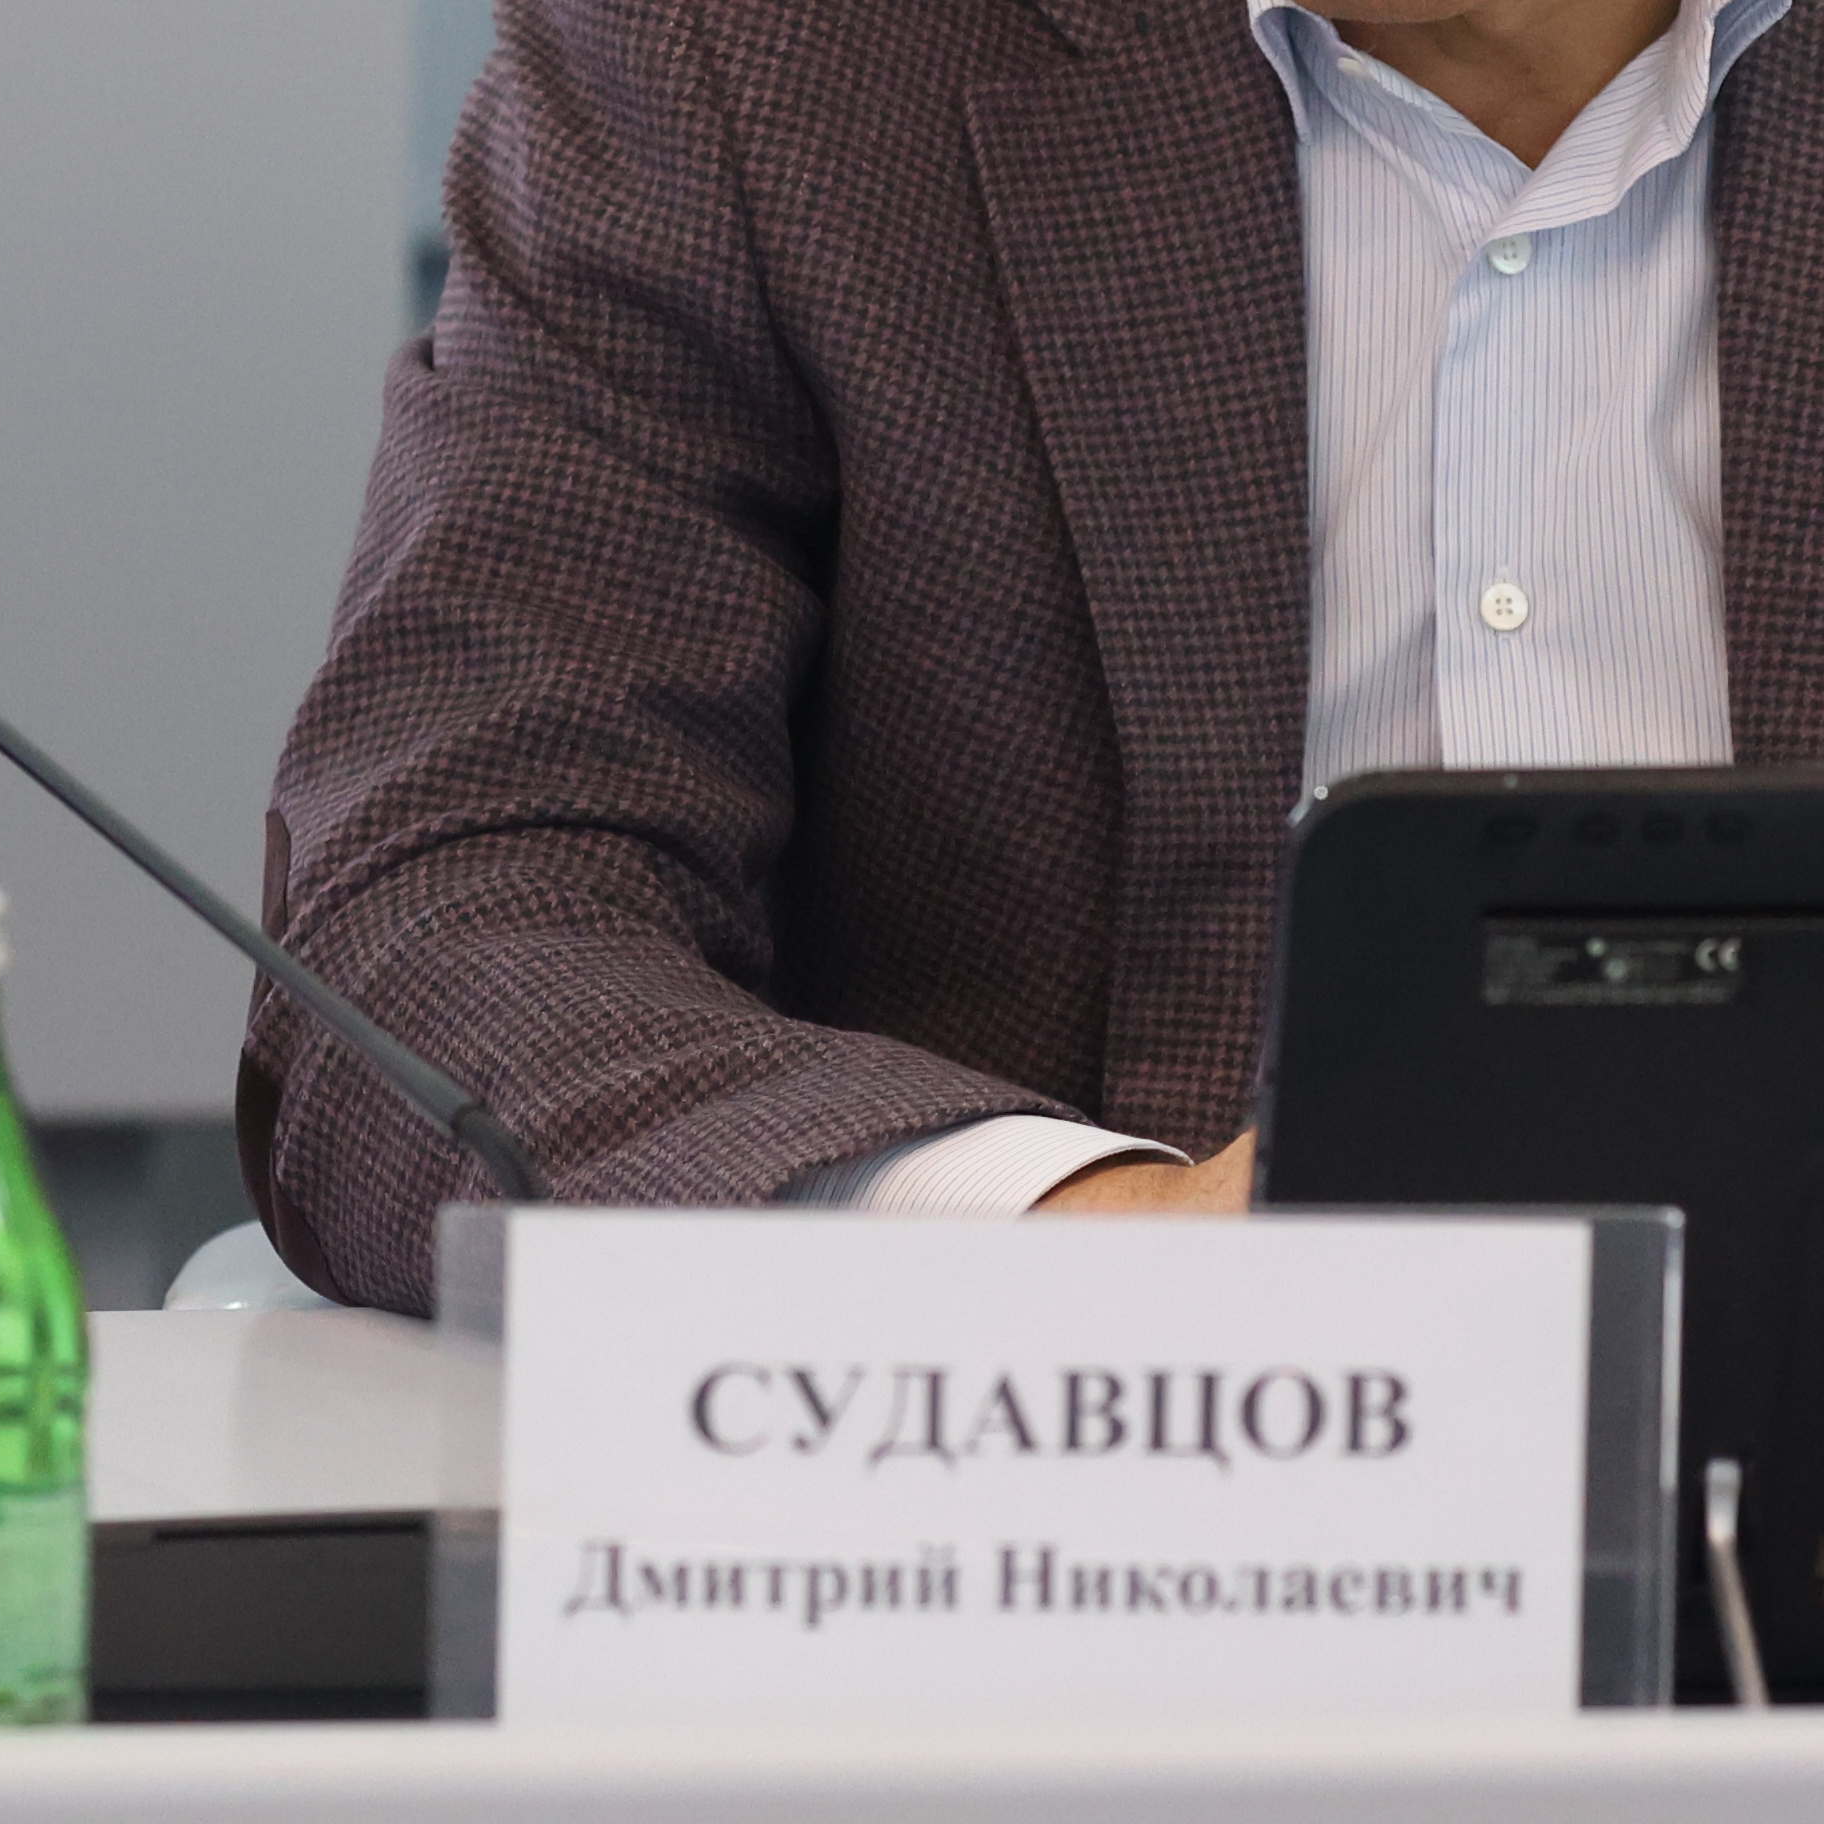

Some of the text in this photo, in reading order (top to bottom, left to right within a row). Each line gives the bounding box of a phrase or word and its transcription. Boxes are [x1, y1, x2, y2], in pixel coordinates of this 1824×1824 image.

[686, 1364, 1412, 1468] СУДАВЦОВ
[564, 1542, 1523, 1629] Дмитрий Николаевич
